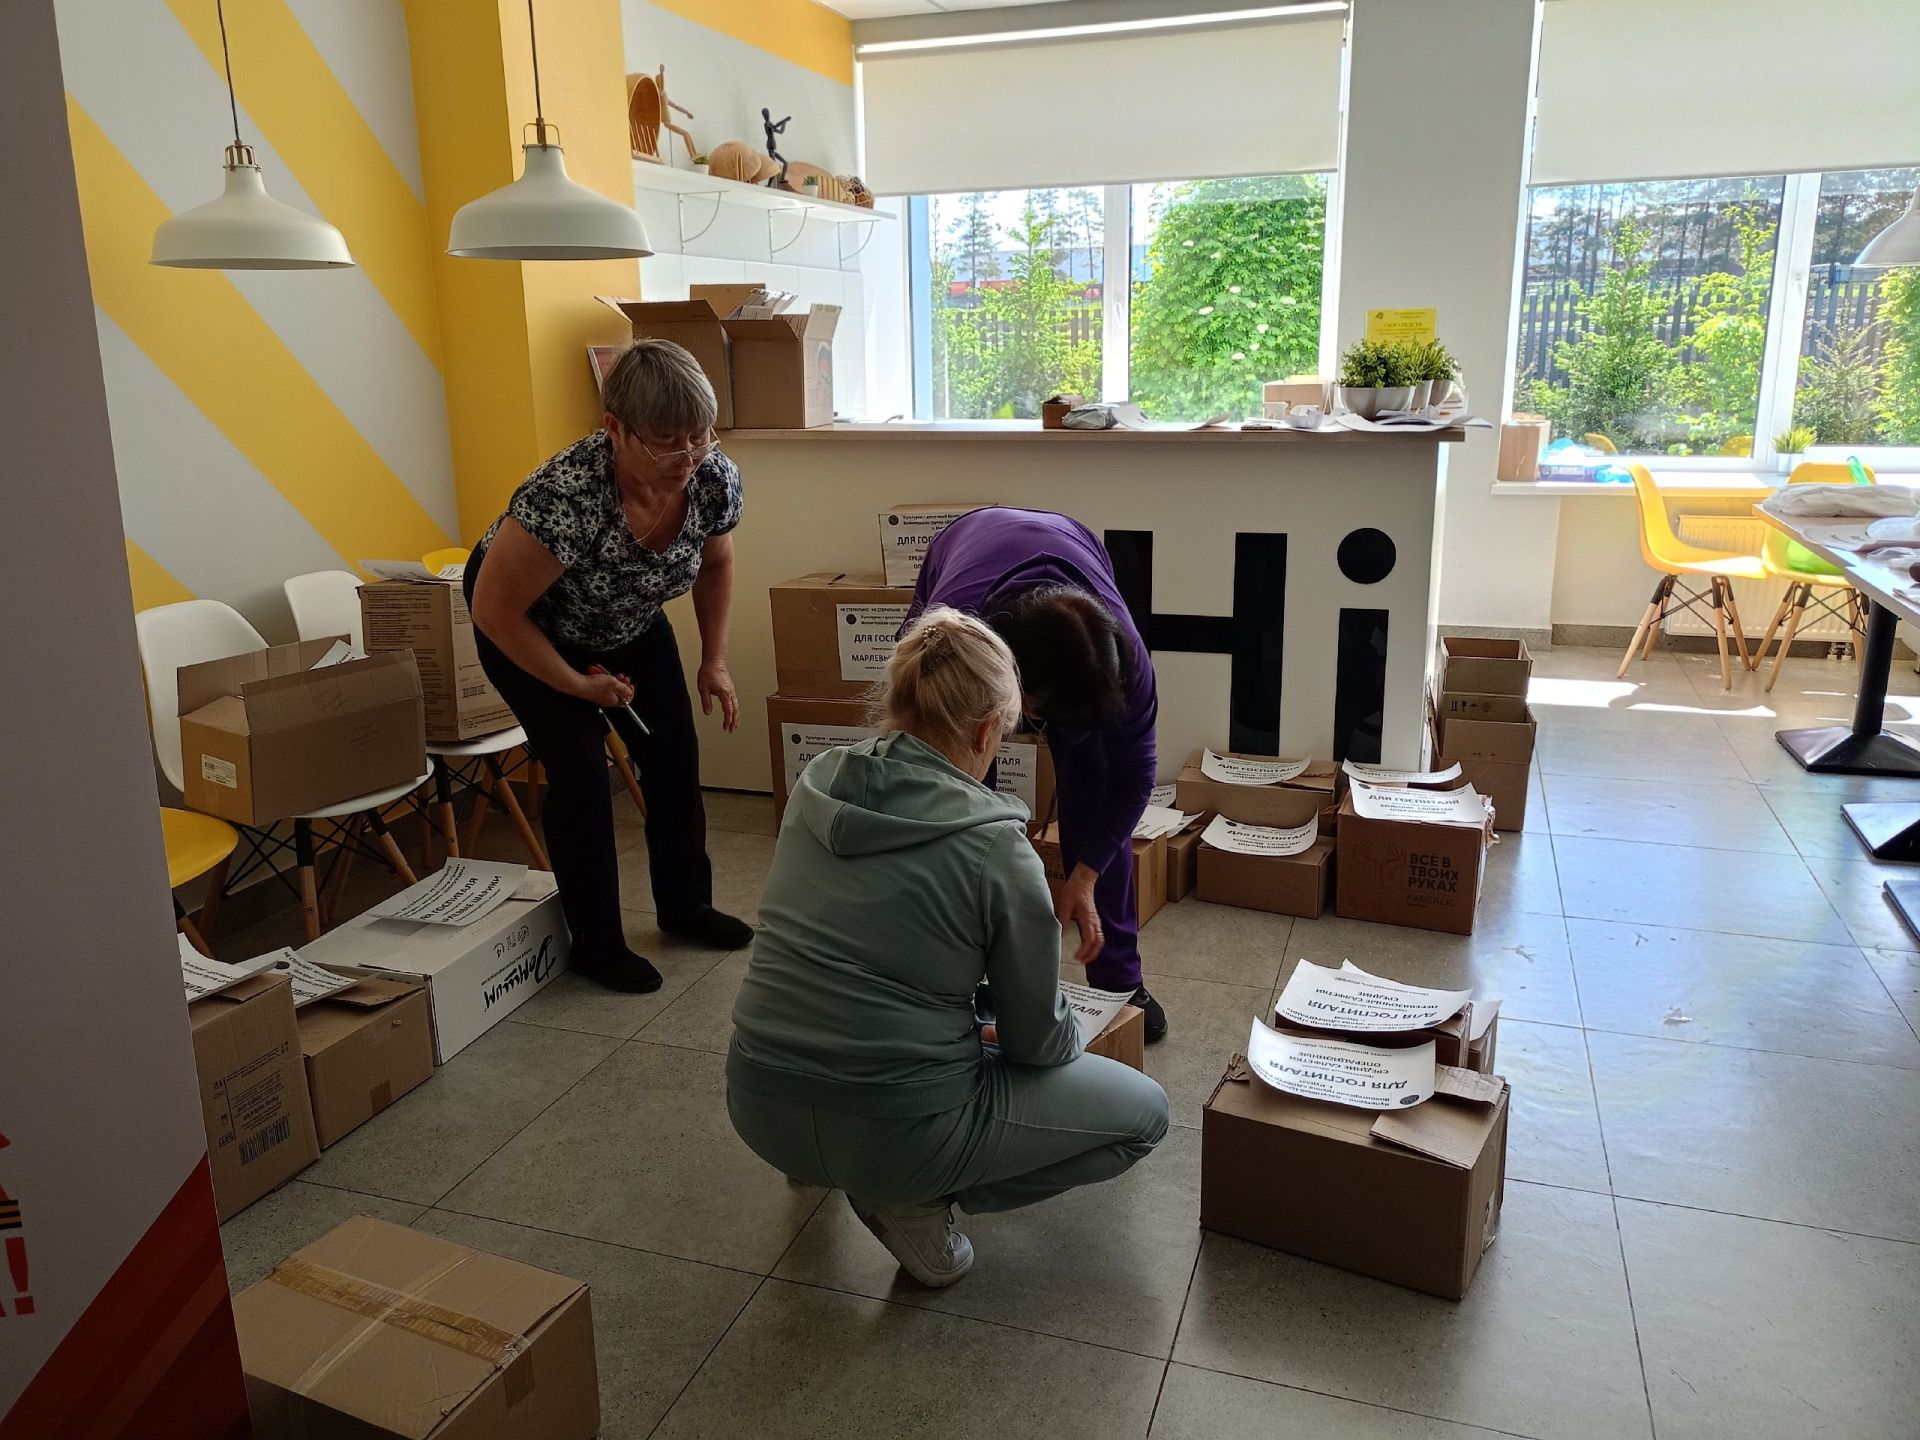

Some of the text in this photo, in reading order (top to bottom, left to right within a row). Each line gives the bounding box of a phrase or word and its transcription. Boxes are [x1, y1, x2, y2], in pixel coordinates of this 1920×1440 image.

[897, 536, 915, 546] ДЛЯ
[854, 634, 872, 643] ДЛЯ
[1394, 797, 1460, 805] ГОСПИТАЛЯ
[1442, 857, 1451, 867] В
[1409, 865, 1460, 882] ТВОИХ
[1408, 877, 1457, 893] РУКАХ
[1315, 988, 1438, 1009] ПЕРЕВЯЗОЧНЫЕ САЛФЕТКИ
[1357, 991, 1399, 1001] СРЕДНИЕ
[1307, 999, 1437, 1020] ДЛЯ ГОСПИТАЛЯ
[1288, 1055, 1389, 1075] СРЕДНИЕ САЛФЕТКИ
[1298, 1051, 1381, 1068] ОПЕРАЦИОННЫЕ
[1269, 1059, 1407, 1090] ДЛЯ ГОСПИТАЛЯ
